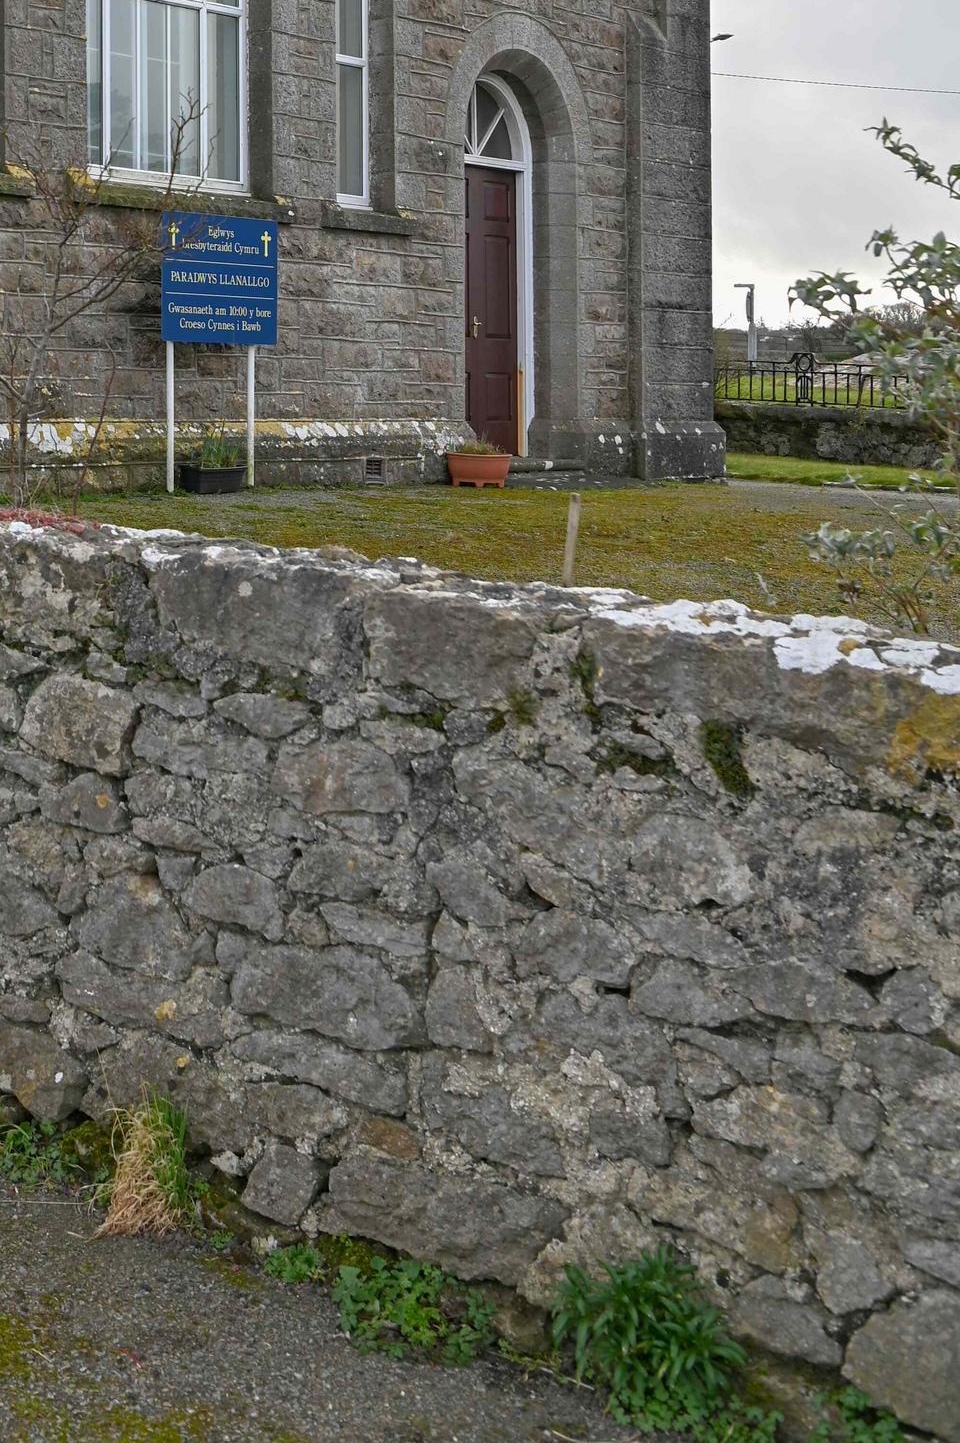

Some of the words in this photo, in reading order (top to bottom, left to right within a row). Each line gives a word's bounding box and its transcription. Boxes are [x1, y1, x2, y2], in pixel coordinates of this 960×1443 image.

[208, 226, 234, 239] Eglwys
[234, 243, 259, 255] Cymru
[171, 271, 217, 284] PARADWYS
[220, 275, 269, 287] LLANALLGO
[168, 302, 212, 315] Gwasanaeth
[215, 307, 226, 315] am
[230, 307, 247, 316] 10:00
[249, 308, 254, 318] y
[255, 307, 271, 317] bore
[180, 319, 206, 329] Croeso
[208, 320, 234, 332] Cynnes
[242, 321, 261, 331] Bawb
